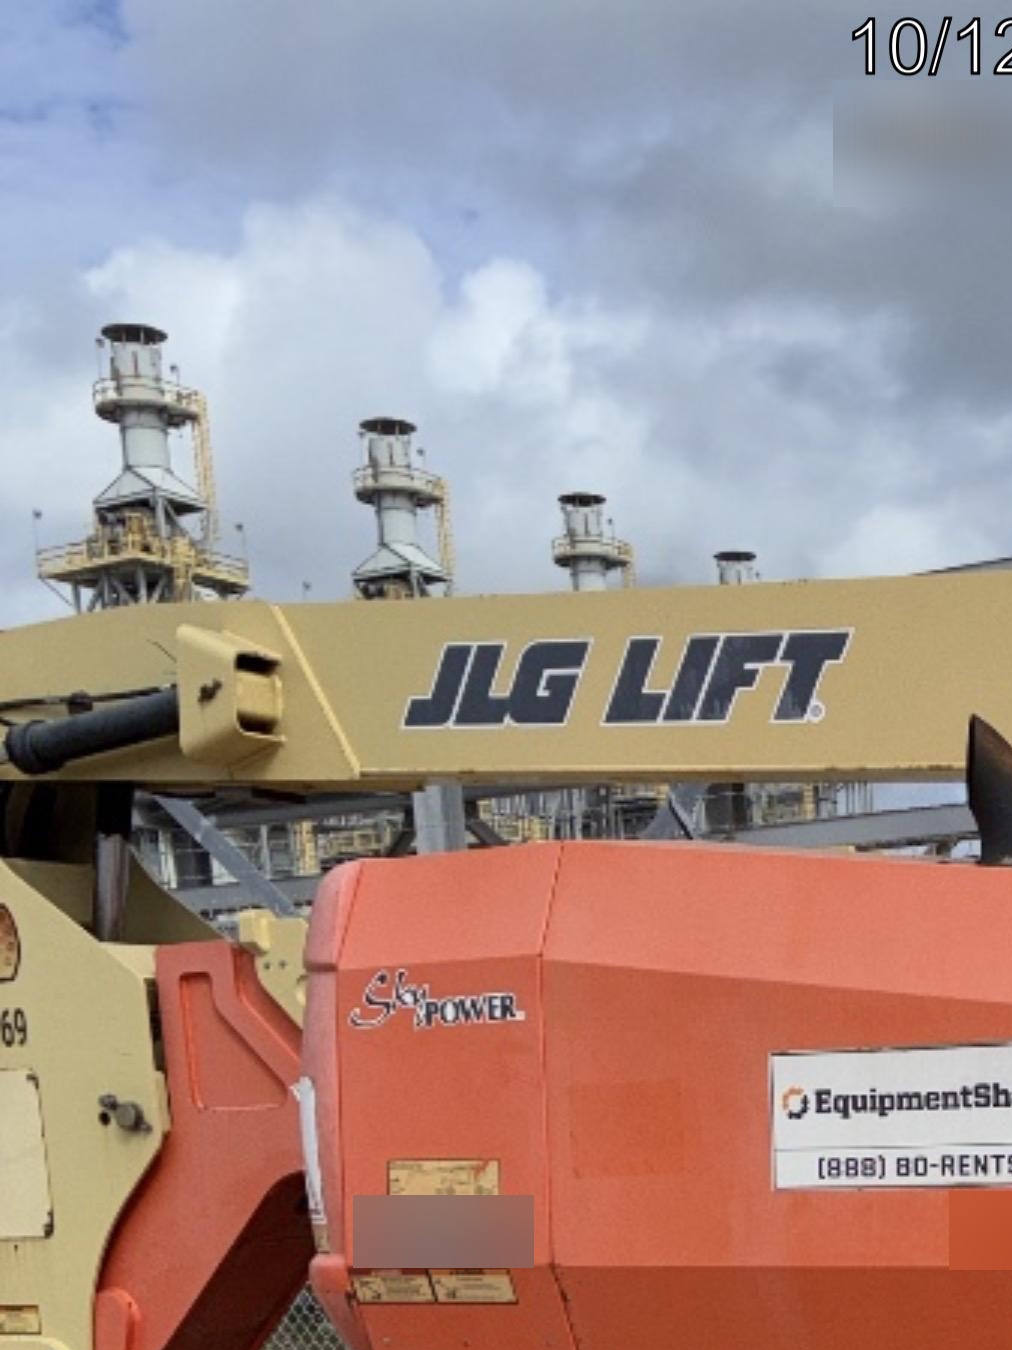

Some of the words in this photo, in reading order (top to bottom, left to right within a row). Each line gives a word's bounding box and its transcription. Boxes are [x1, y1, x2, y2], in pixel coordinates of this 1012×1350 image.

[401, 638, 593, 729] JLG
[601, 628, 854, 727] LIFT
[423, 992, 518, 1027] POWER
[818, 1154, 886, 1180] (888)
